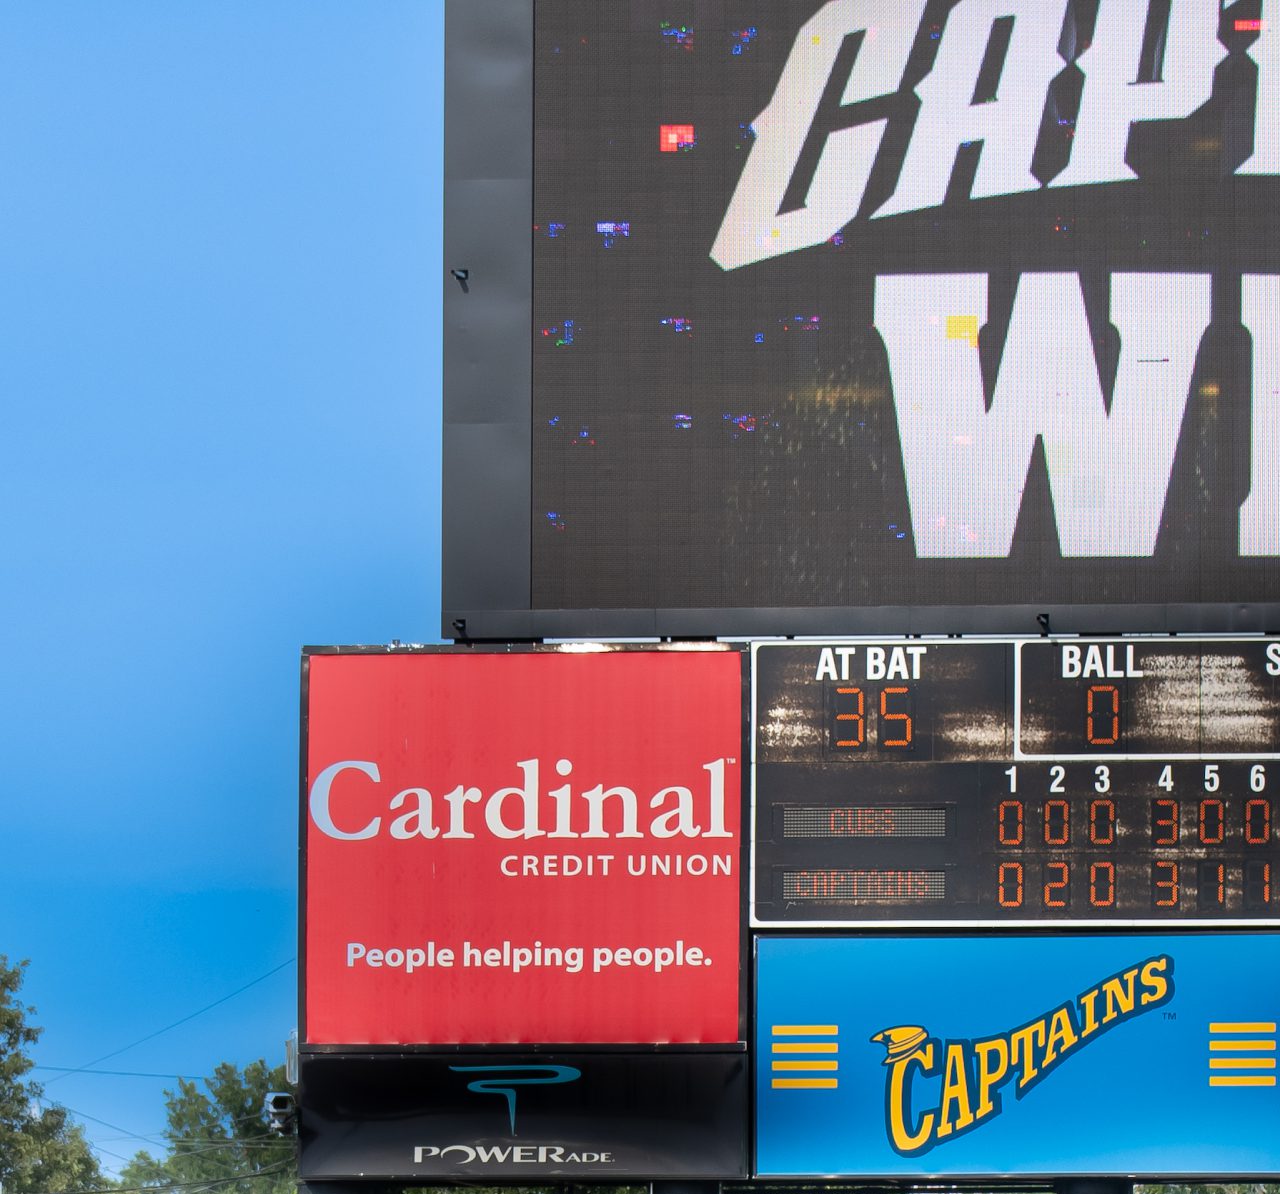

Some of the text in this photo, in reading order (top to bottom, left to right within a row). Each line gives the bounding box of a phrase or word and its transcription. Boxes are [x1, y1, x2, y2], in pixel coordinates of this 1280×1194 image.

[815, 646, 927, 681] AT BAT
[1061, 645, 1144, 679] BALL
[835, 687, 913, 747] 35
[1086, 685, 1119, 745] 0
[308, 758, 733, 841] Cardinal
[1004, 767, 1017, 792] 1
[1049, 766, 1065, 792] 2
[1093, 766, 1110, 792] 3
[1157, 766, 1174, 792] 4
[1203, 765, 1220, 792] 5
[1250, 765, 1266, 791] 6
[829, 809, 895, 833] CUBS
[998, 800, 1023, 845] 0
[1044, 800, 1069, 845] 0
[1090, 800, 1115, 845] 0
[1156, 799, 1179, 844] 3
[1199, 799, 1224, 844] 0
[1245, 799, 1270, 844] 0
[500, 853, 733, 878] CREDIT UNION
[796, 870, 929, 896] CAPTAINS
[998, 862, 1023, 907] 0
[1044, 862, 1068, 907] 2
[1090, 862, 1114, 907] 0
[1156, 861, 1178, 906] 3
[346, 940, 713, 974] People helping people.
[887, 955, 1172, 1155] CAPTAINS
